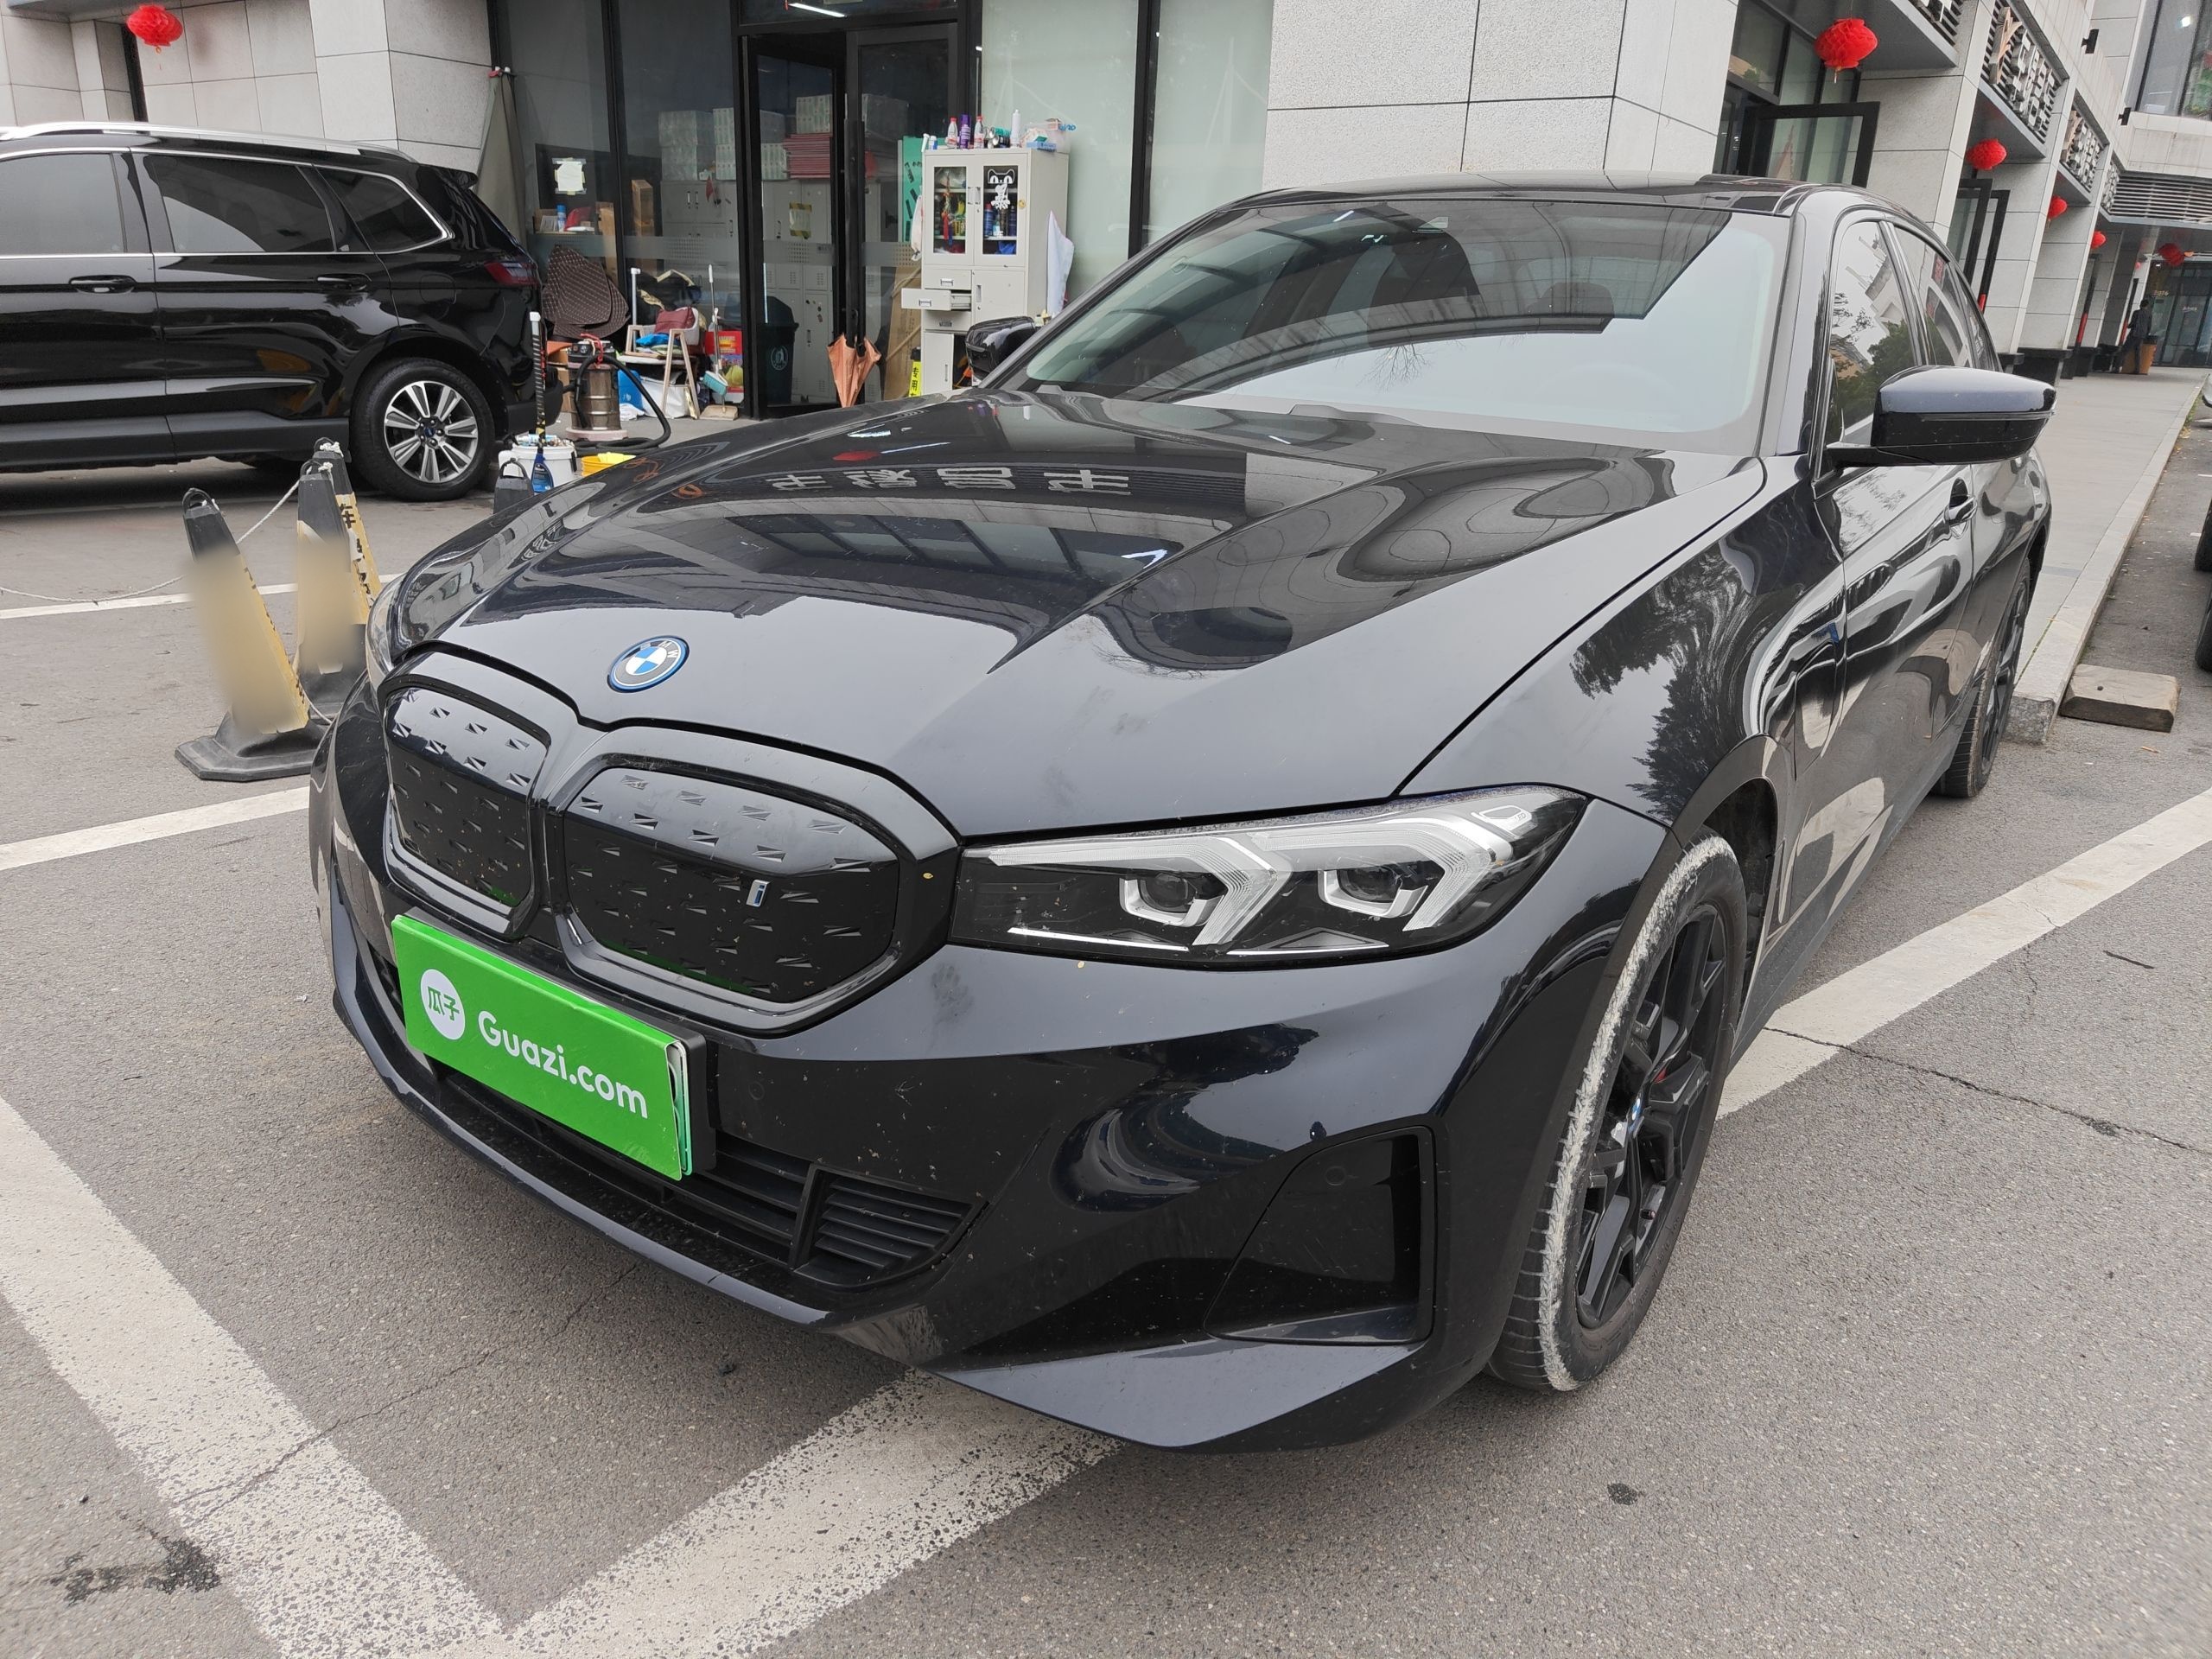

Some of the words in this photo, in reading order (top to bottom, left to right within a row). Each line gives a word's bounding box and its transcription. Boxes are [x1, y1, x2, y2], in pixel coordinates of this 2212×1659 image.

[640, 640, 679, 658] BMW
[428, 985, 461, 1021] 瓜子
[478, 1010, 648, 1119] Guazi.com
